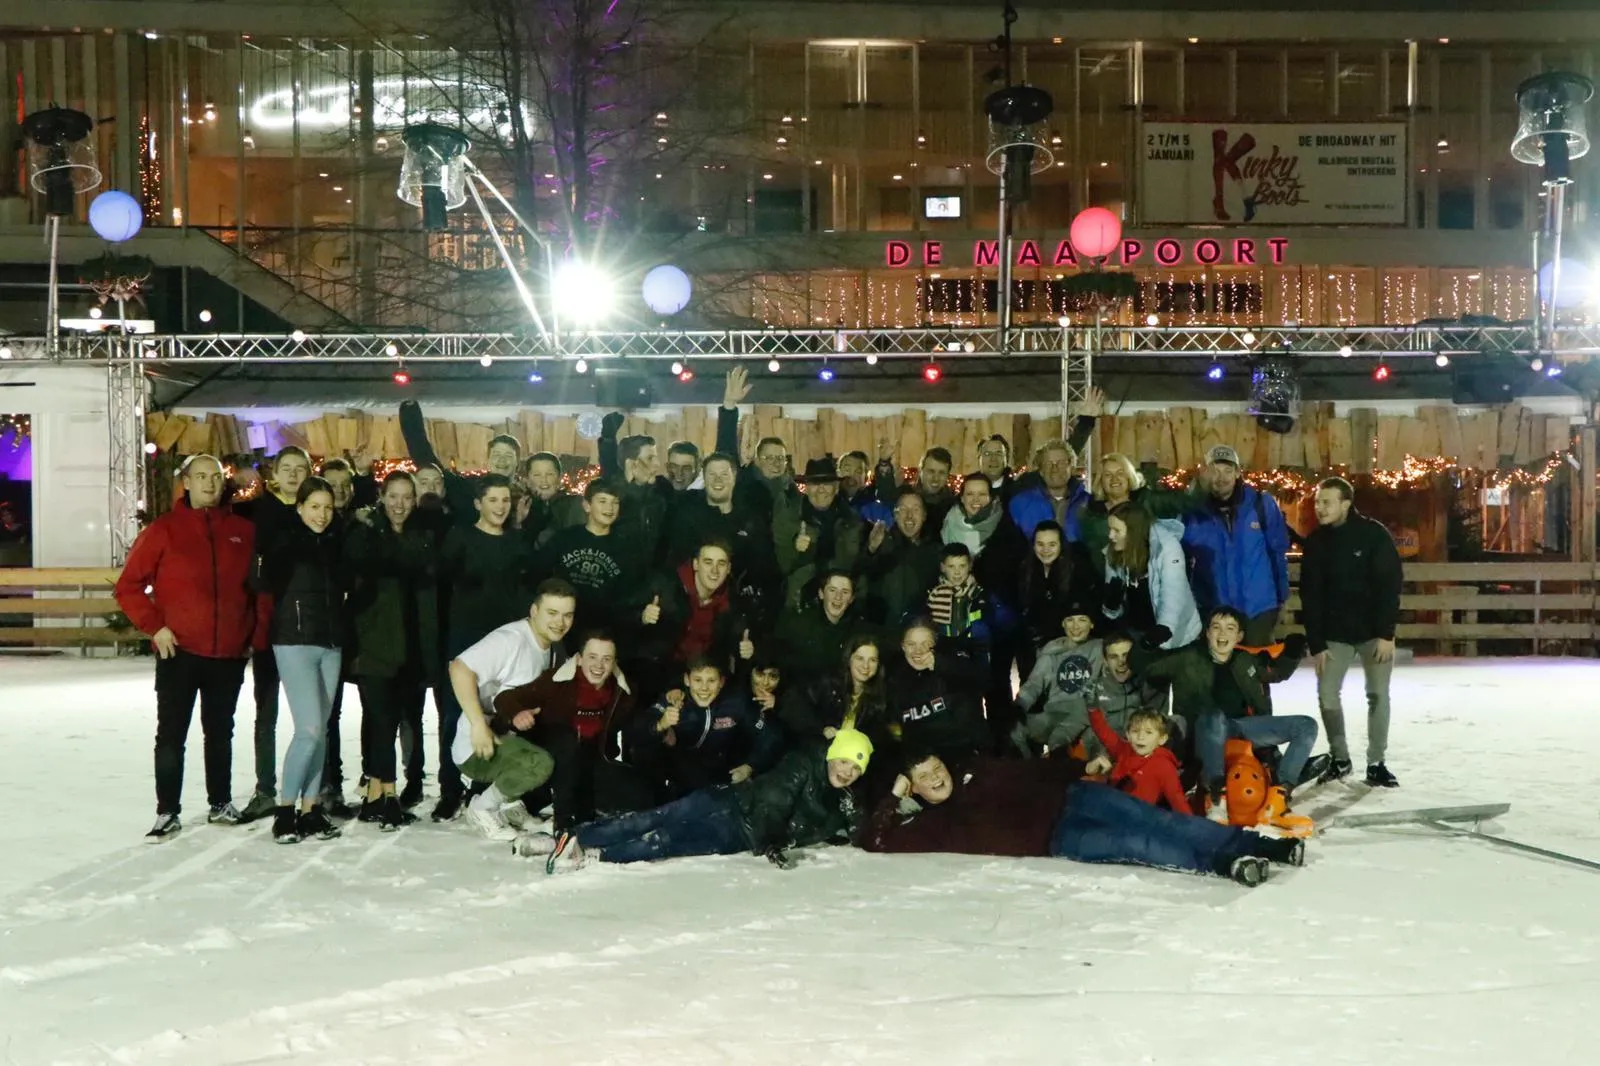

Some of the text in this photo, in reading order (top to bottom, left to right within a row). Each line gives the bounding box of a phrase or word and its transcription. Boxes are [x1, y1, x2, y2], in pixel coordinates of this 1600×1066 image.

[1147, 133, 1190, 147] 2 T/M 5
[1298, 135, 1397, 147] DE BROADWAY HIT
[1147, 149, 1195, 161] JANUARI
[1211, 129, 1301, 221] Kinky
[1253, 180, 1309, 207] Boots
[886, 237, 1291, 267] DE MAAPOORT
[1059, 669, 1091, 681] NASA
[902, 703, 931, 723] FILA
